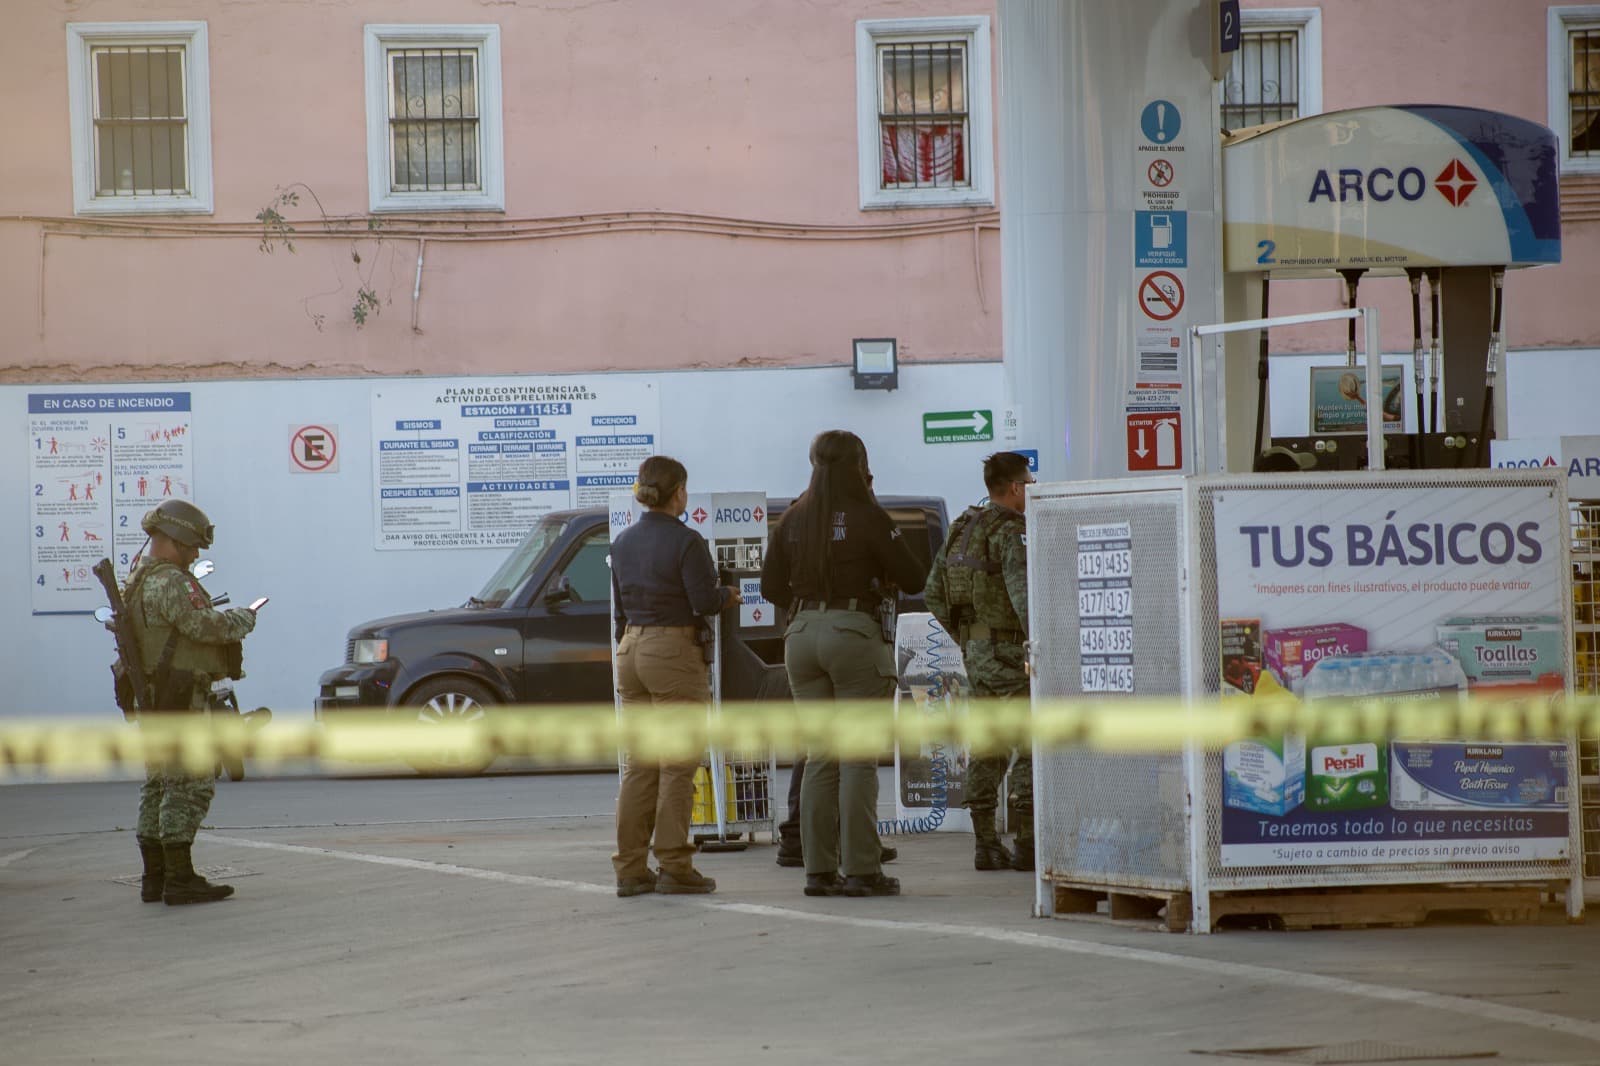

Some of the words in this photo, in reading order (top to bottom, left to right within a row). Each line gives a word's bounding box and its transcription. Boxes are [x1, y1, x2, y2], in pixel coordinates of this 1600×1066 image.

[1224, 11, 1232, 40] 2
[1308, 167, 1426, 202] ARCO
[1256, 240, 1276, 264] 2
[494, 386, 586, 394] CONTINGENCIAS
[44, 399, 60, 409] EN
[62, 398, 96, 408] CASO
[100, 398, 116, 408] DE
[118, 398, 174, 408] INCENDIO
[436, 395, 511, 403] ACTIVIDADES
[514, 392, 597, 402] PRELIMINARES
[465, 404, 517, 416] ESTACIÓN
[528, 404, 568, 415] 11454
[594, 416, 634, 425] INCENDIOS
[118, 428, 126, 440] 5
[482, 431, 551, 440] CLASIFICACIÓN
[35, 438, 42, 450] 1
[304, 434, 326, 462] E
[35, 485, 44, 496] 2
[120, 482, 125, 493] 1
[482, 482, 556, 490] ACTIVIDADES
[120, 516, 128, 527] 2
[611, 511, 626, 526] ARCO
[715, 508, 750, 523] ARCO
[35, 526, 44, 538] 3
[1239, 524, 1334, 568] TUS
[1346, 510, 1542, 566] BÁSICOS
[121, 554, 128, 564] 3
[1080, 554, 1101, 575] $119
[1106, 552, 1129, 574] $435
[37, 575, 45, 586] 4
[1307, 584, 1325, 593] con
[1328, 580, 1351, 593] fines
[1353, 580, 1409, 593] ilustrativas,
[1411, 580, 1421, 592] el
[1424, 580, 1468, 594] producto
[1470, 580, 1500, 594] puede
[1081, 592, 1102, 613] $177
[1082, 630, 1104, 650] $436
[1108, 630, 1132, 650] $395
[1304, 644, 1349, 662] BOLSAS
[1474, 644, 1538, 662] Toallas
[1083, 668, 1105, 688] $479
[1324, 754, 1365, 771] Persil
[1454, 760, 1476, 774] Papel
[1460, 778, 1483, 790] Bath
[1483, 778, 1510, 790] Tissue
[1258, 820, 1337, 837] Tenemos
[1345, 818, 1384, 835] todo
[1392, 817, 1408, 834] lo
[1414, 820, 1446, 837] que
[1452, 816, 1533, 833] necesitas
[1316, 850, 1323, 858] a
[1327, 846, 1368, 858] cambio
[1371, 846, 1385, 857] de
[1389, 845, 1430, 859] precios
[1434, 846, 1449, 856] sin
[1452, 844, 1488, 858] previo
[1490, 844, 1520, 855] aviso
